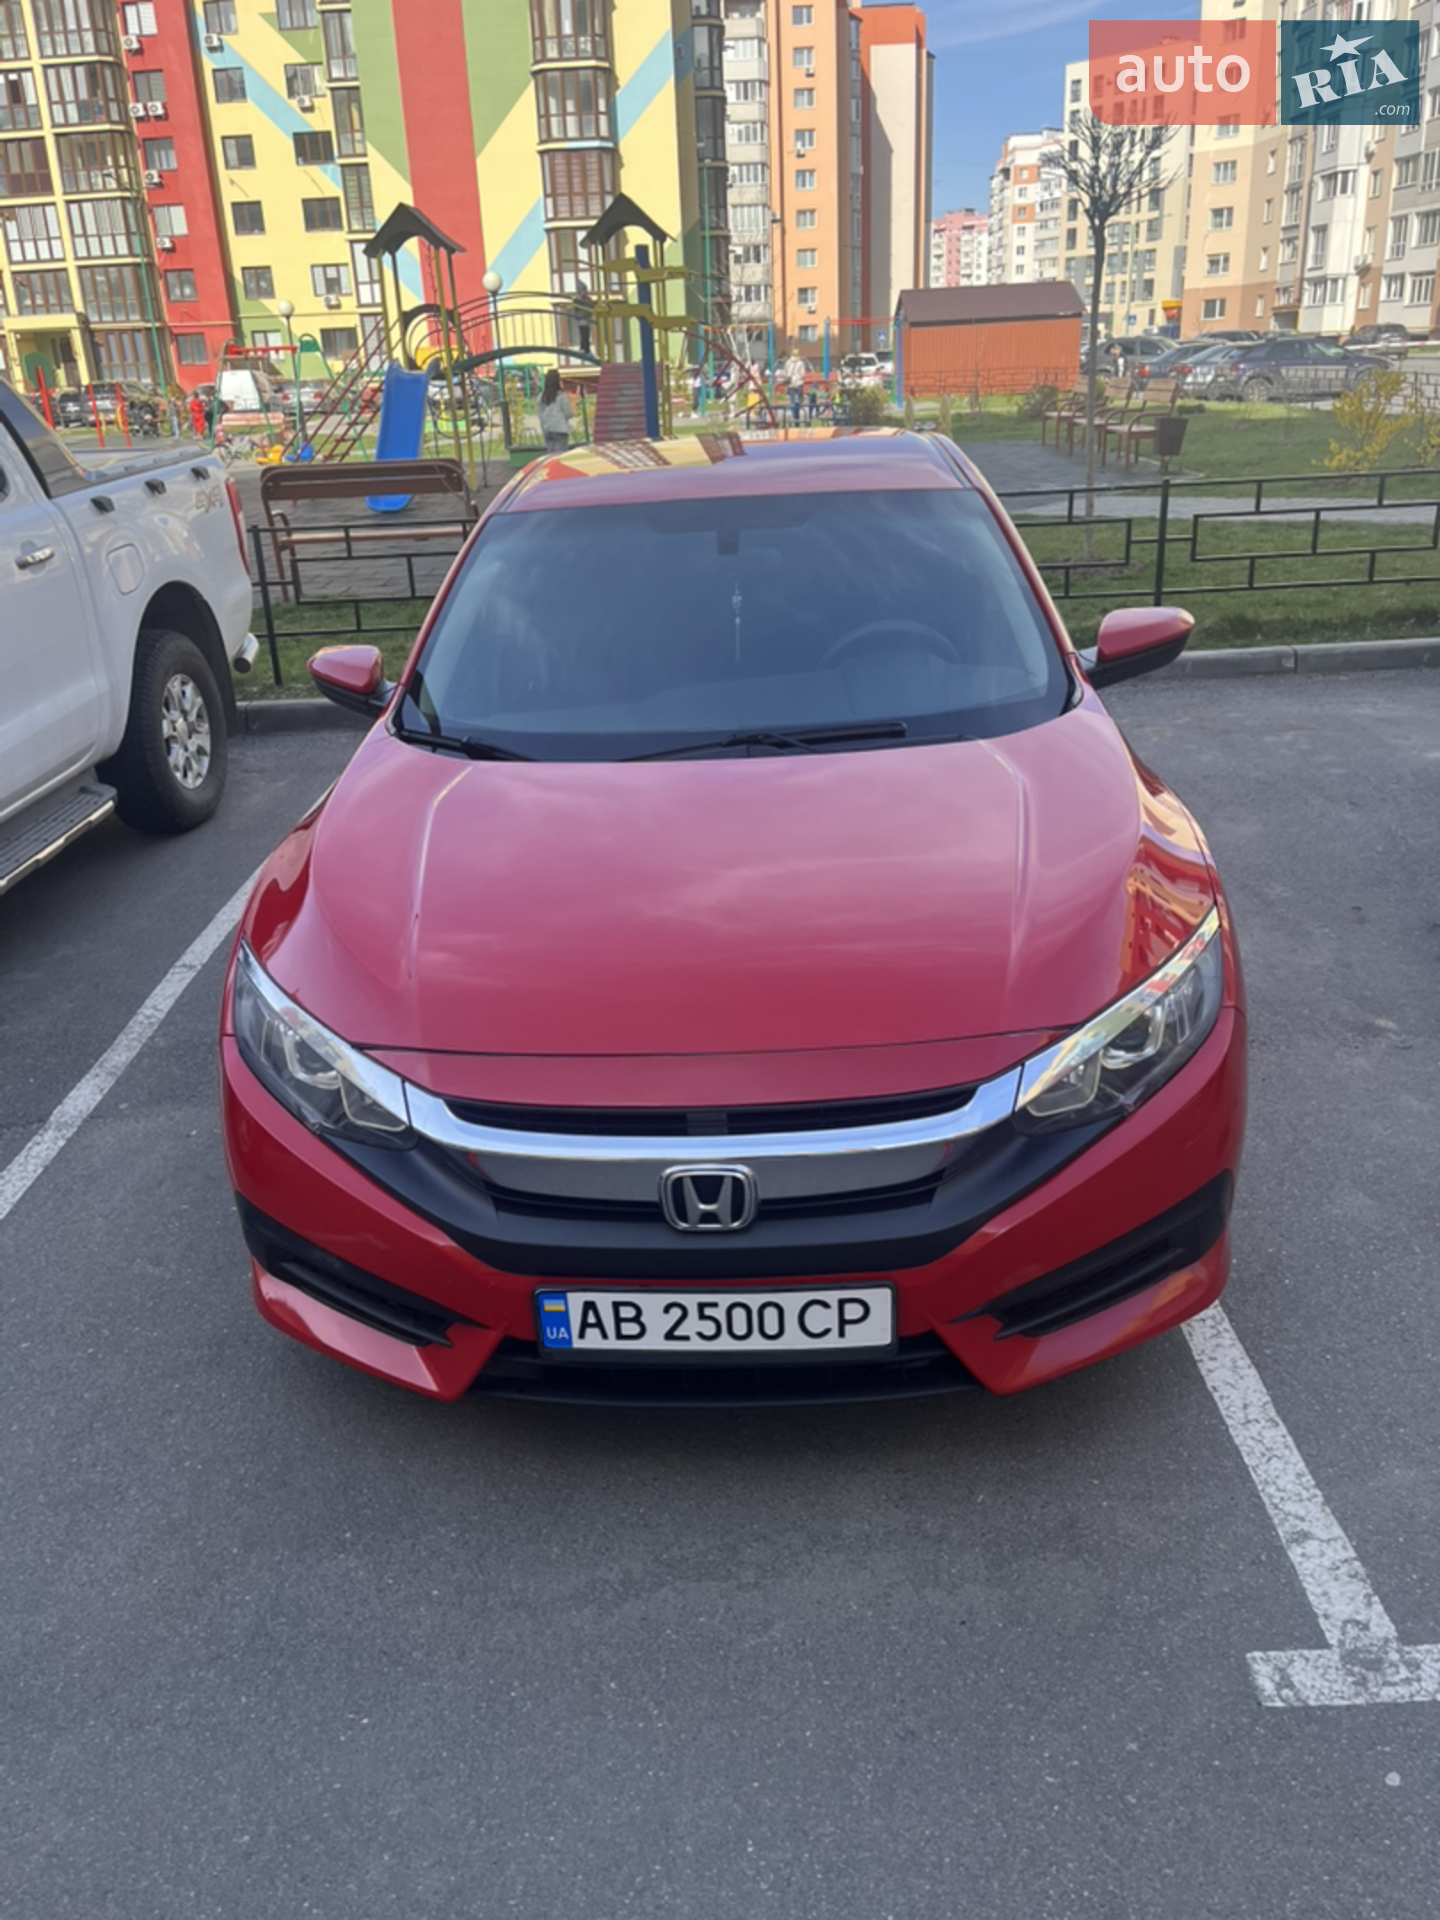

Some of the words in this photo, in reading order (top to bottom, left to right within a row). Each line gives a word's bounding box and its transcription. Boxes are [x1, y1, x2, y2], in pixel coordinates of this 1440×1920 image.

[546, 1326, 570, 1340] UA
[577, 1300, 647, 1340] AB
[662, 1301, 785, 1342] 2500
[797, 1298, 871, 1339] CP
